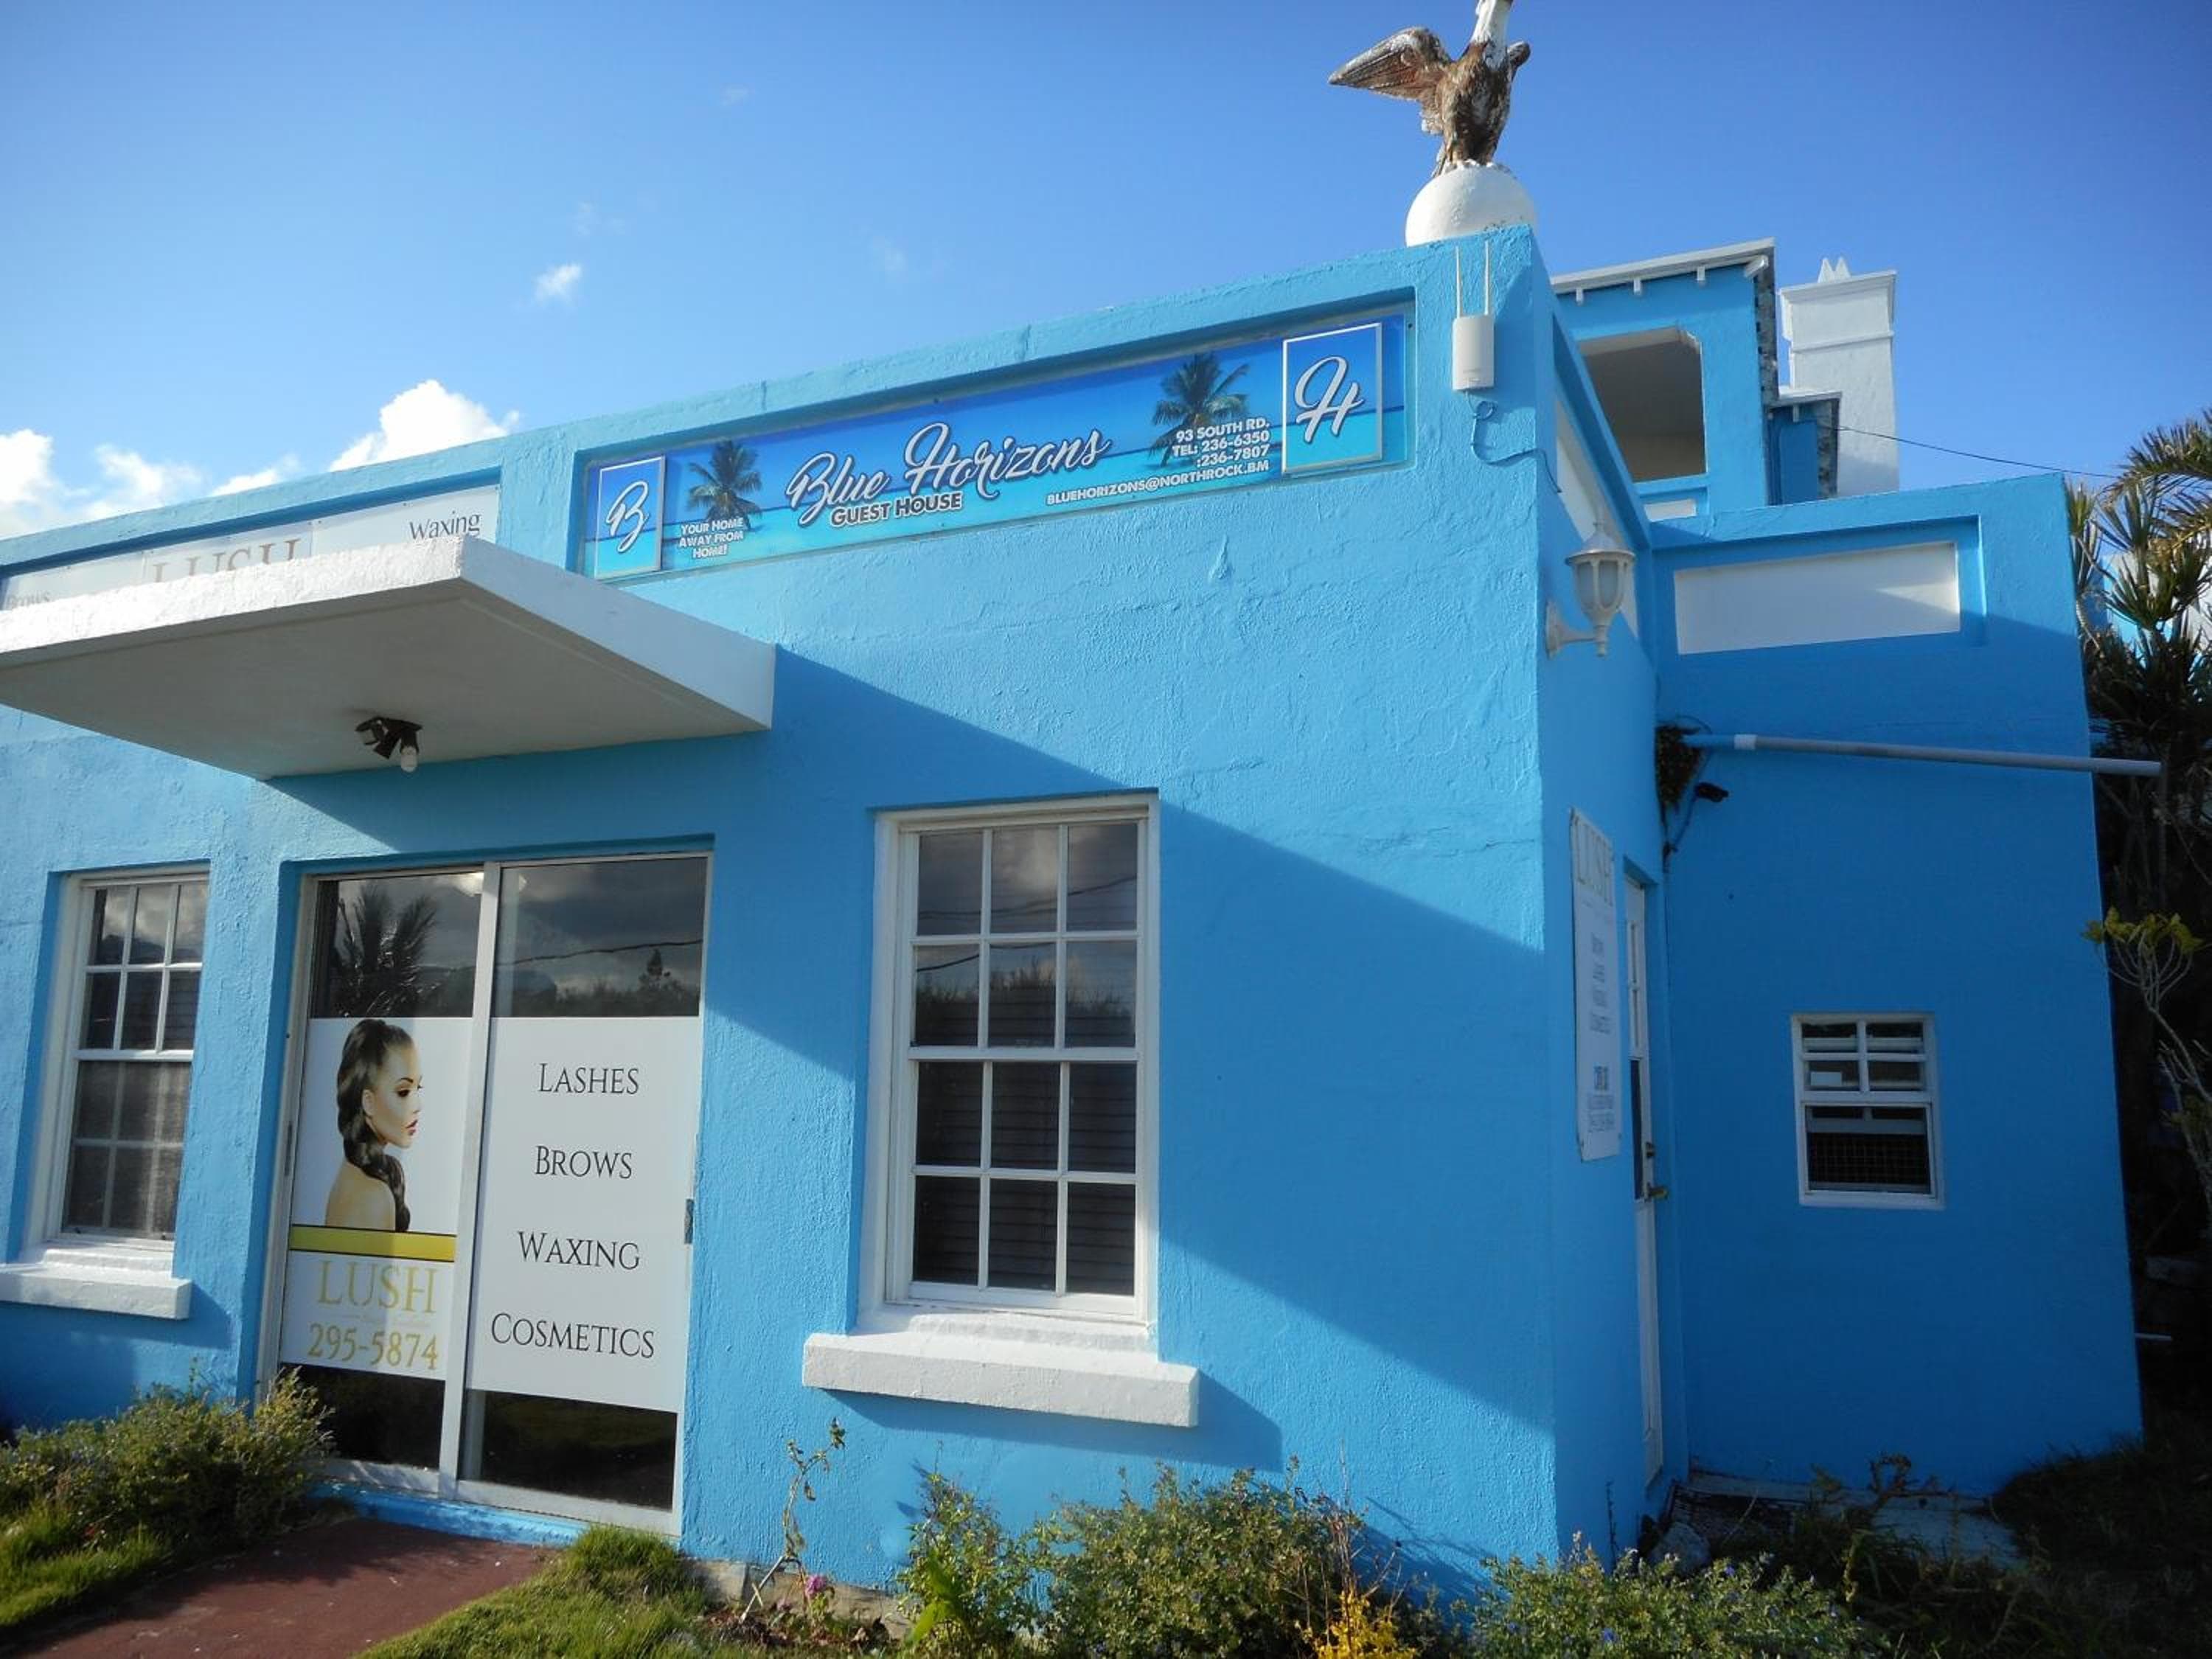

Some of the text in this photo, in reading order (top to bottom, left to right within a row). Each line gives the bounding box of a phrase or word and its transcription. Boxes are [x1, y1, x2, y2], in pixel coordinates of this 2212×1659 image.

[1172, 430, 1270, 457] TEL: 236-6350
[1175, 417, 1270, 443] 93 SOUTH RD.
[787, 422, 1112, 526] Blue Horizons
[1047, 459, 1270, 506] BLUEHORIZONS@NORTHROCK.BM
[409, 509, 482, 538] Waxing
[605, 479, 649, 552] B
[681, 516, 744, 535] YOUR HOME
[831, 492, 963, 526] GUEST HOUSE
[679, 530, 744, 548] AWAY FROM
[692, 544, 728, 558] HOME!
[538, 1062, 640, 1095] LASHES
[535, 1145, 633, 1180] BROWS
[517, 1230, 641, 1270] WAXING
[318, 1260, 438, 1314] LUSH
[307, 1322, 438, 1370] 295-5874
[490, 1312, 655, 1359] COSMETICS
